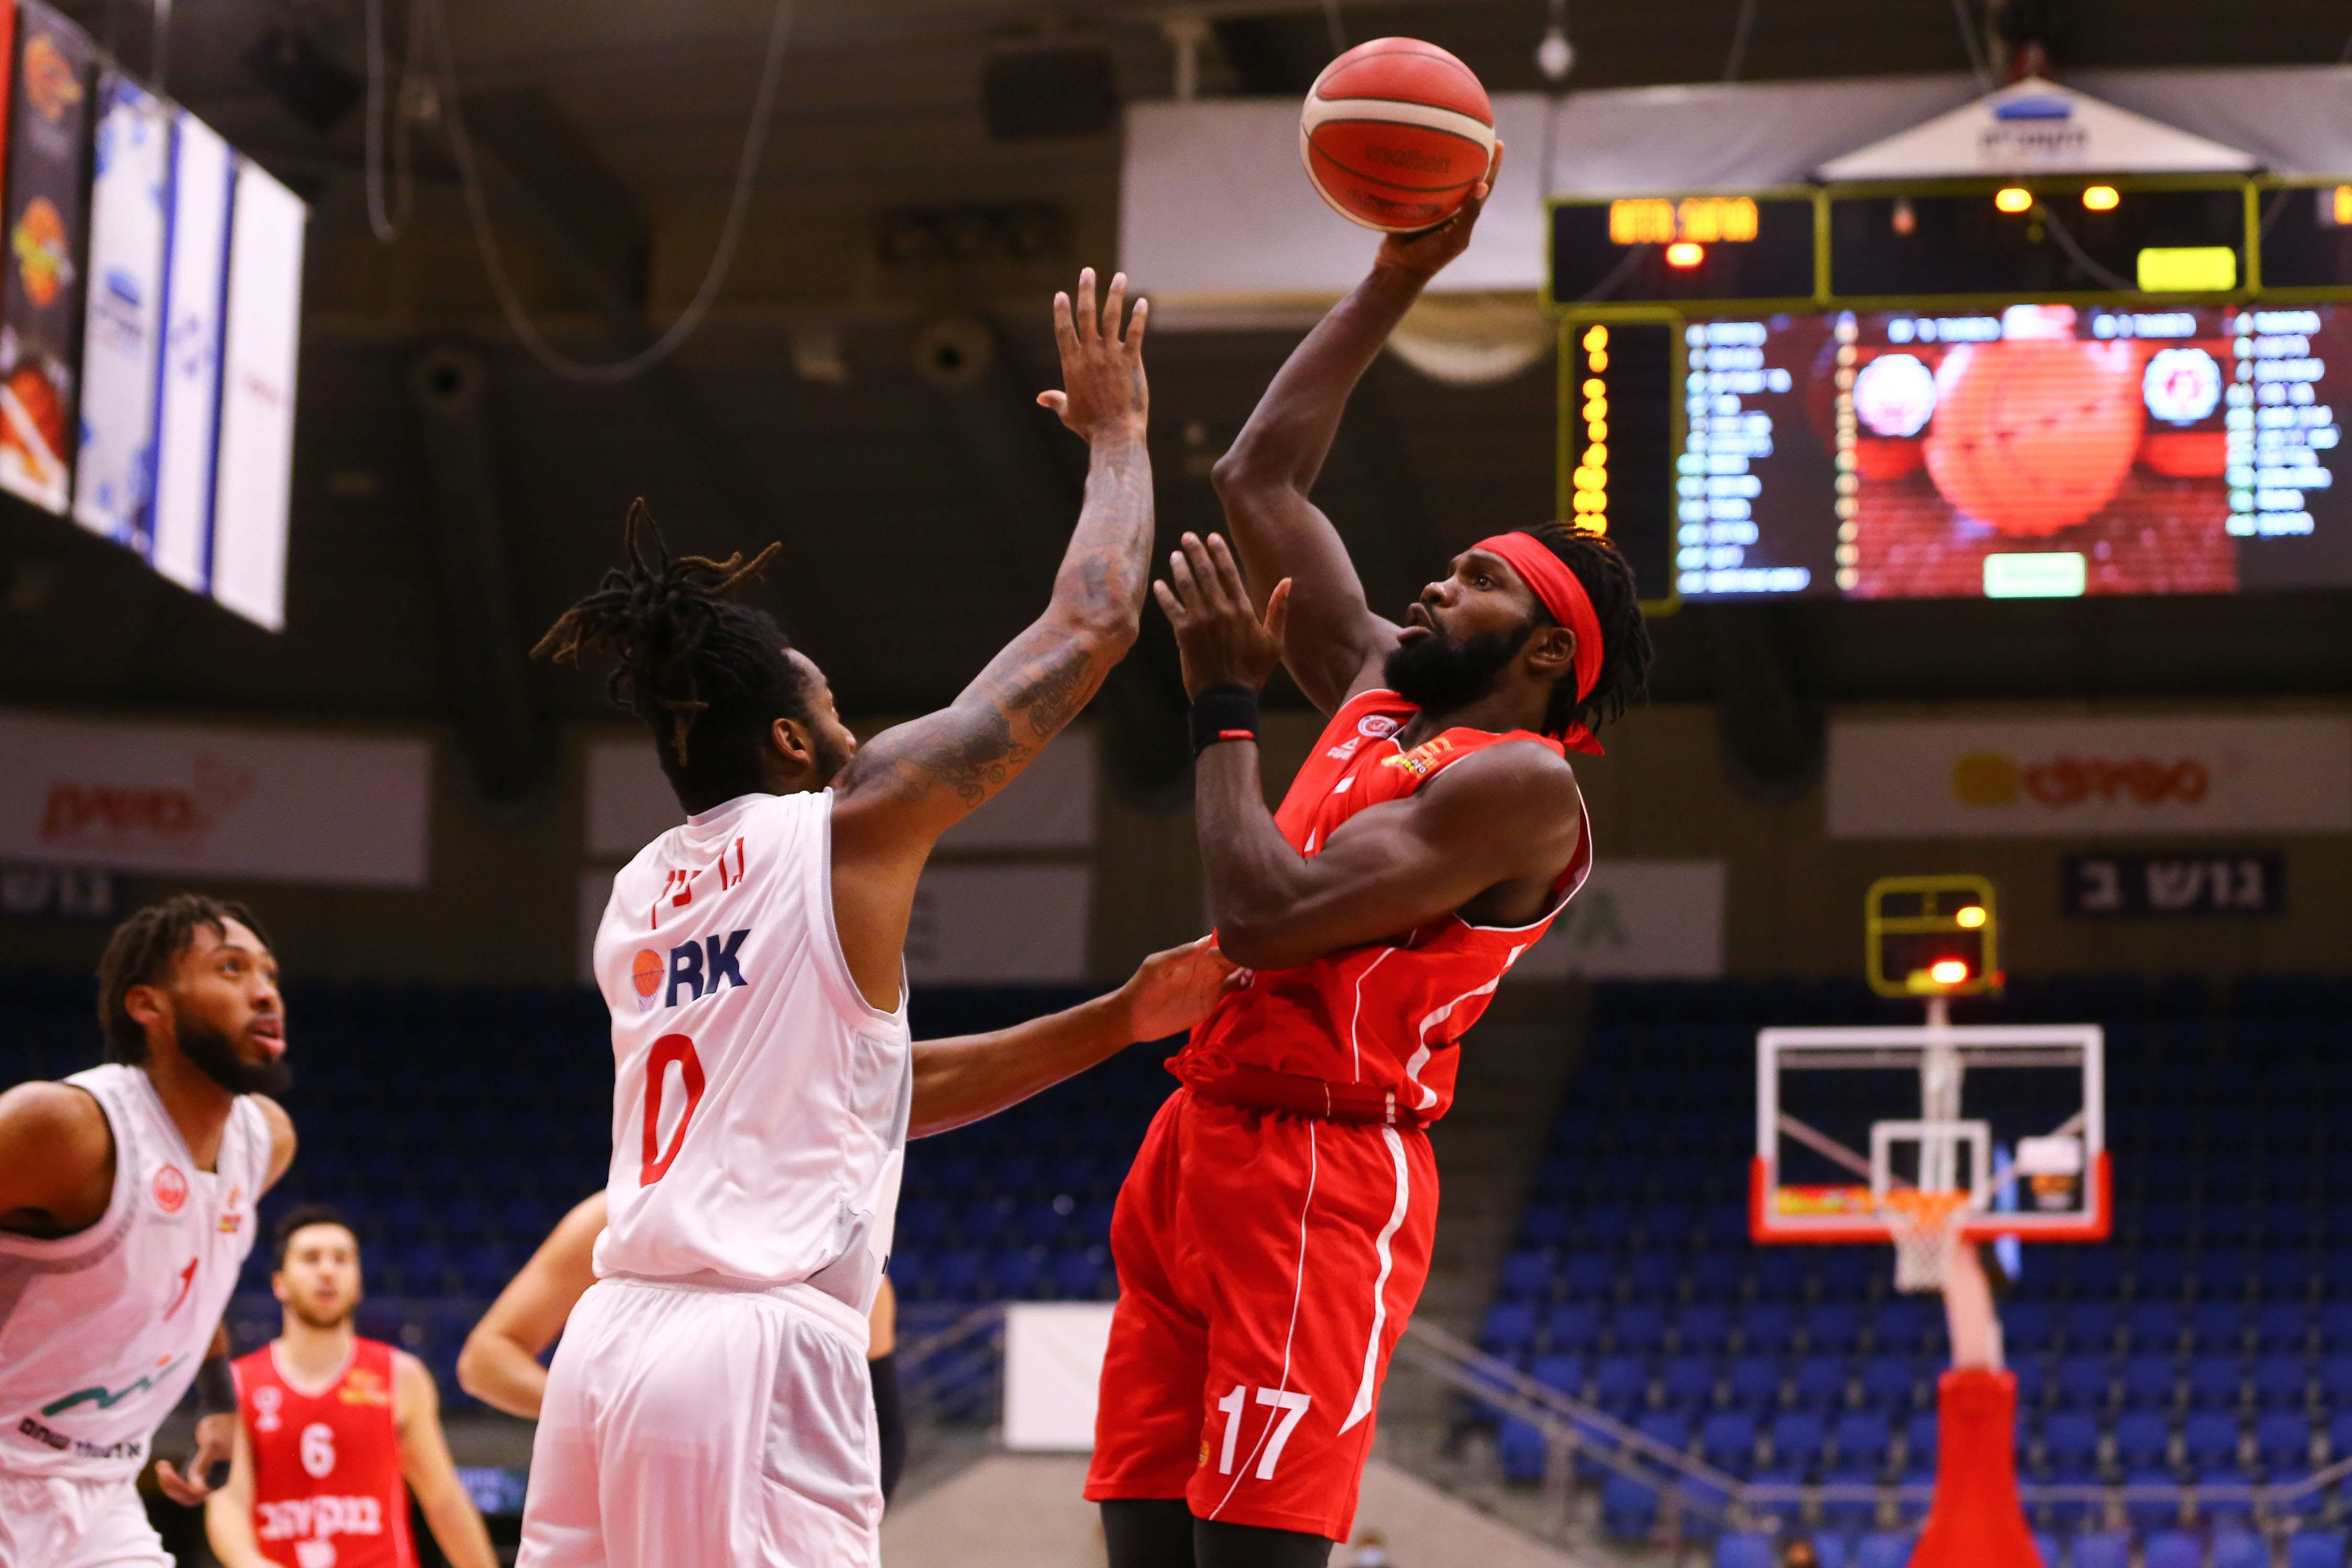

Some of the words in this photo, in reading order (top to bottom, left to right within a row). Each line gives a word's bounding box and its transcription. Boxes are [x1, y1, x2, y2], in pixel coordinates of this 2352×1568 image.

[1365, 145, 1451, 173] molten
[2078, 860, 2123, 910] ב
[2146, 858, 2266, 911] גוש
[640, 1034, 705, 1188] 0
[165, 1256, 199, 1322] 1
[300, 1423, 336, 1478] 6
[1218, 1385, 1311, 1481] 17
